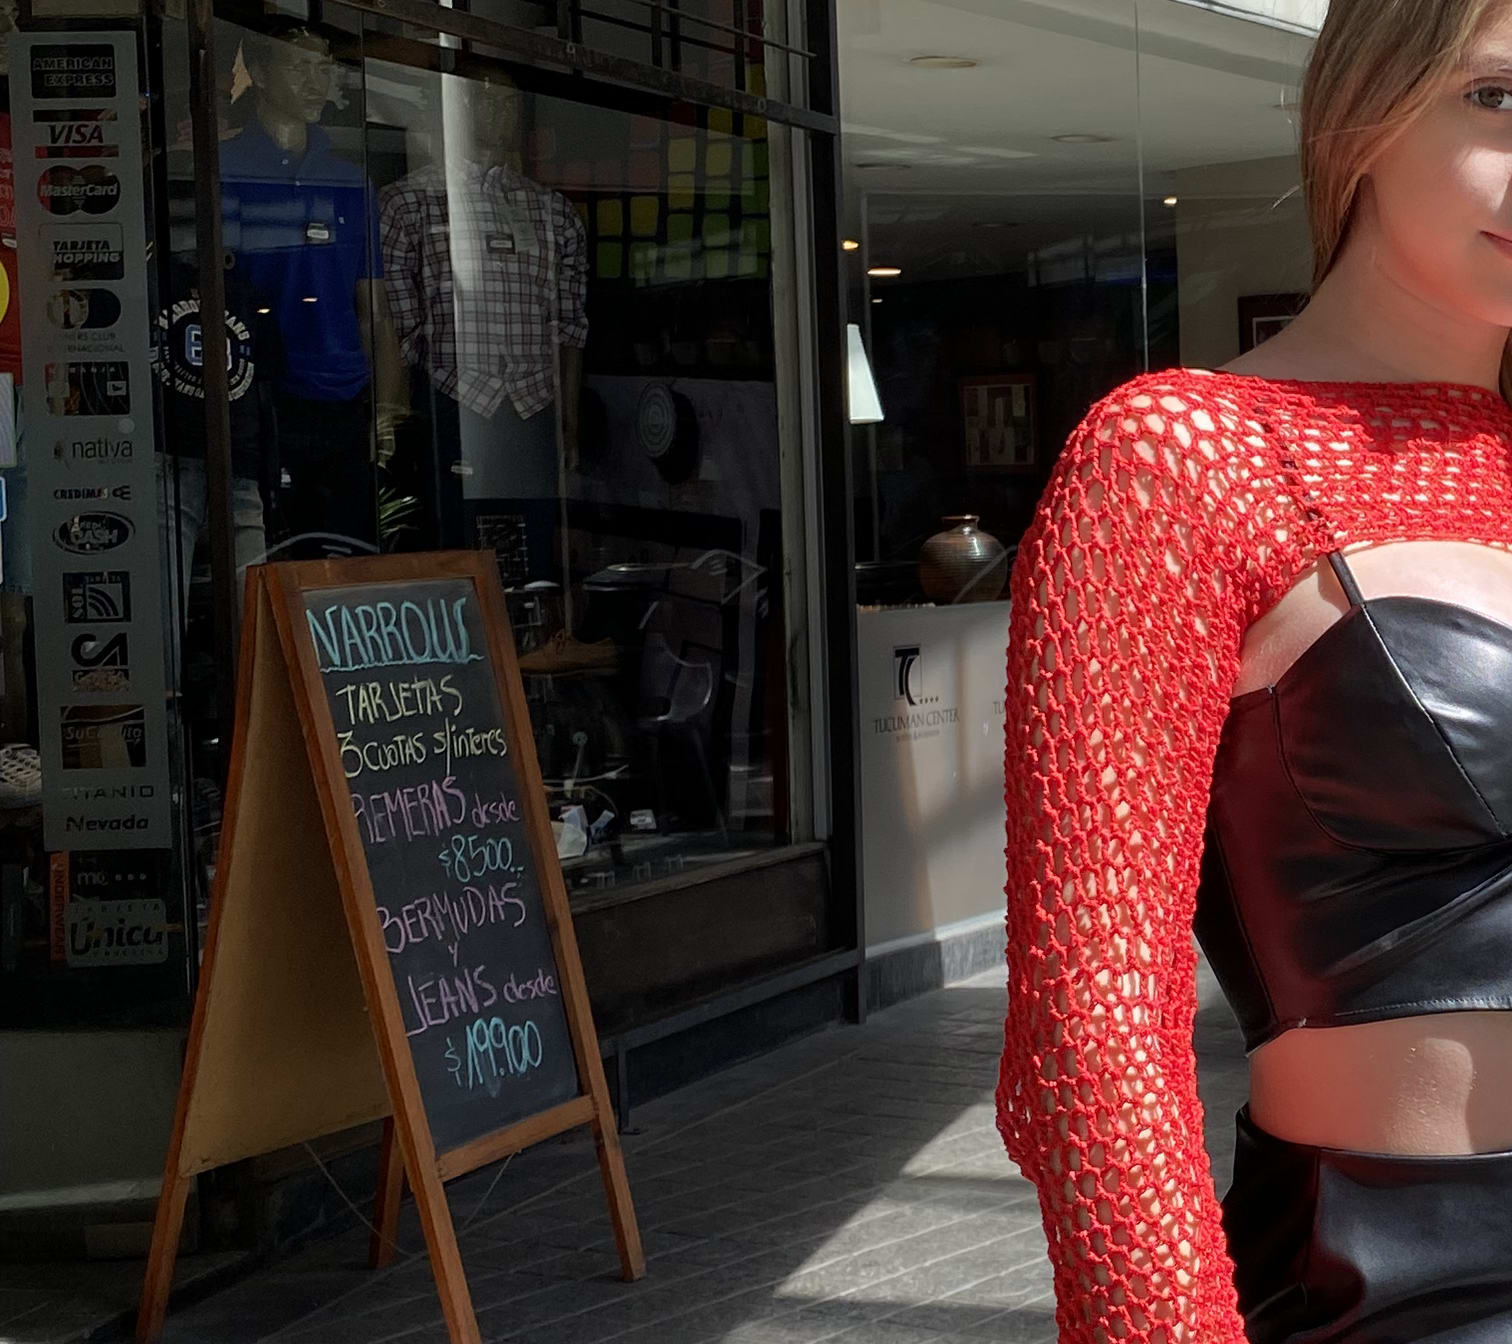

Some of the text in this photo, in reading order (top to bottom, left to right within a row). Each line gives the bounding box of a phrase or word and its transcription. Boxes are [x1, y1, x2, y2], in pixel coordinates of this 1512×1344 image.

[32, 57, 113, 71] AMERICAN
[43, 74, 114, 87] EXPRESS
[48, 123, 104, 144] VISA
[40, 183, 119, 197] MasterCard
[53, 241, 110, 251] TARJETA
[72, 438, 133, 459] nativa
[336, 674, 463, 726] TARJETAS
[926, 707, 961, 728] CENTER
[336, 730, 364, 778] 3
[350, 776, 521, 844] REMERAS desde
[66, 815, 149, 832] Nevada
[375, 881, 527, 954] BERMUDAS
[406, 965, 557, 1038] JEANS desde
